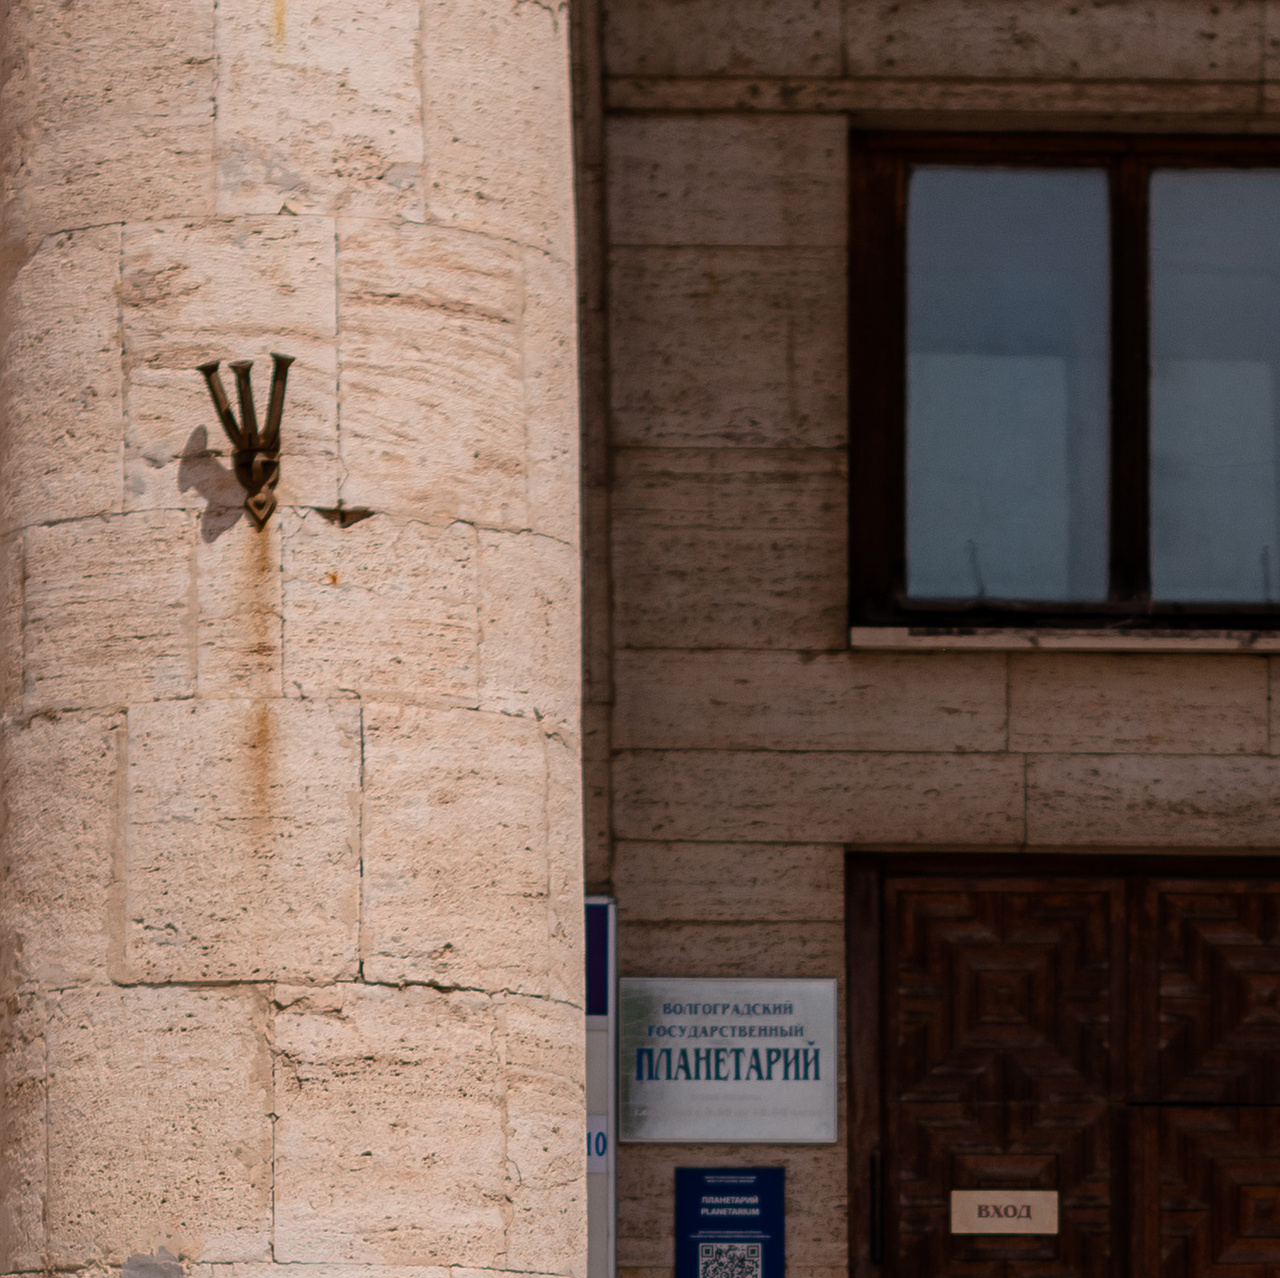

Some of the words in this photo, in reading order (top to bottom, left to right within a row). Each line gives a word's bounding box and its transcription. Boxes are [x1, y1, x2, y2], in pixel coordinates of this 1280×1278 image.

[662, 1000, 794, 1015] ВОЛГОГРАДСКИЙ
[647, 1023, 804, 1039] ГОСУДАРСТВЕННЫЙ
[635, 1041, 821, 1081] ПЛАНЕТАРИЙ
[702, 1195, 758, 1204] ПЛАНЕТАРИЙ
[977, 1204, 1032, 1220] ВХОД
